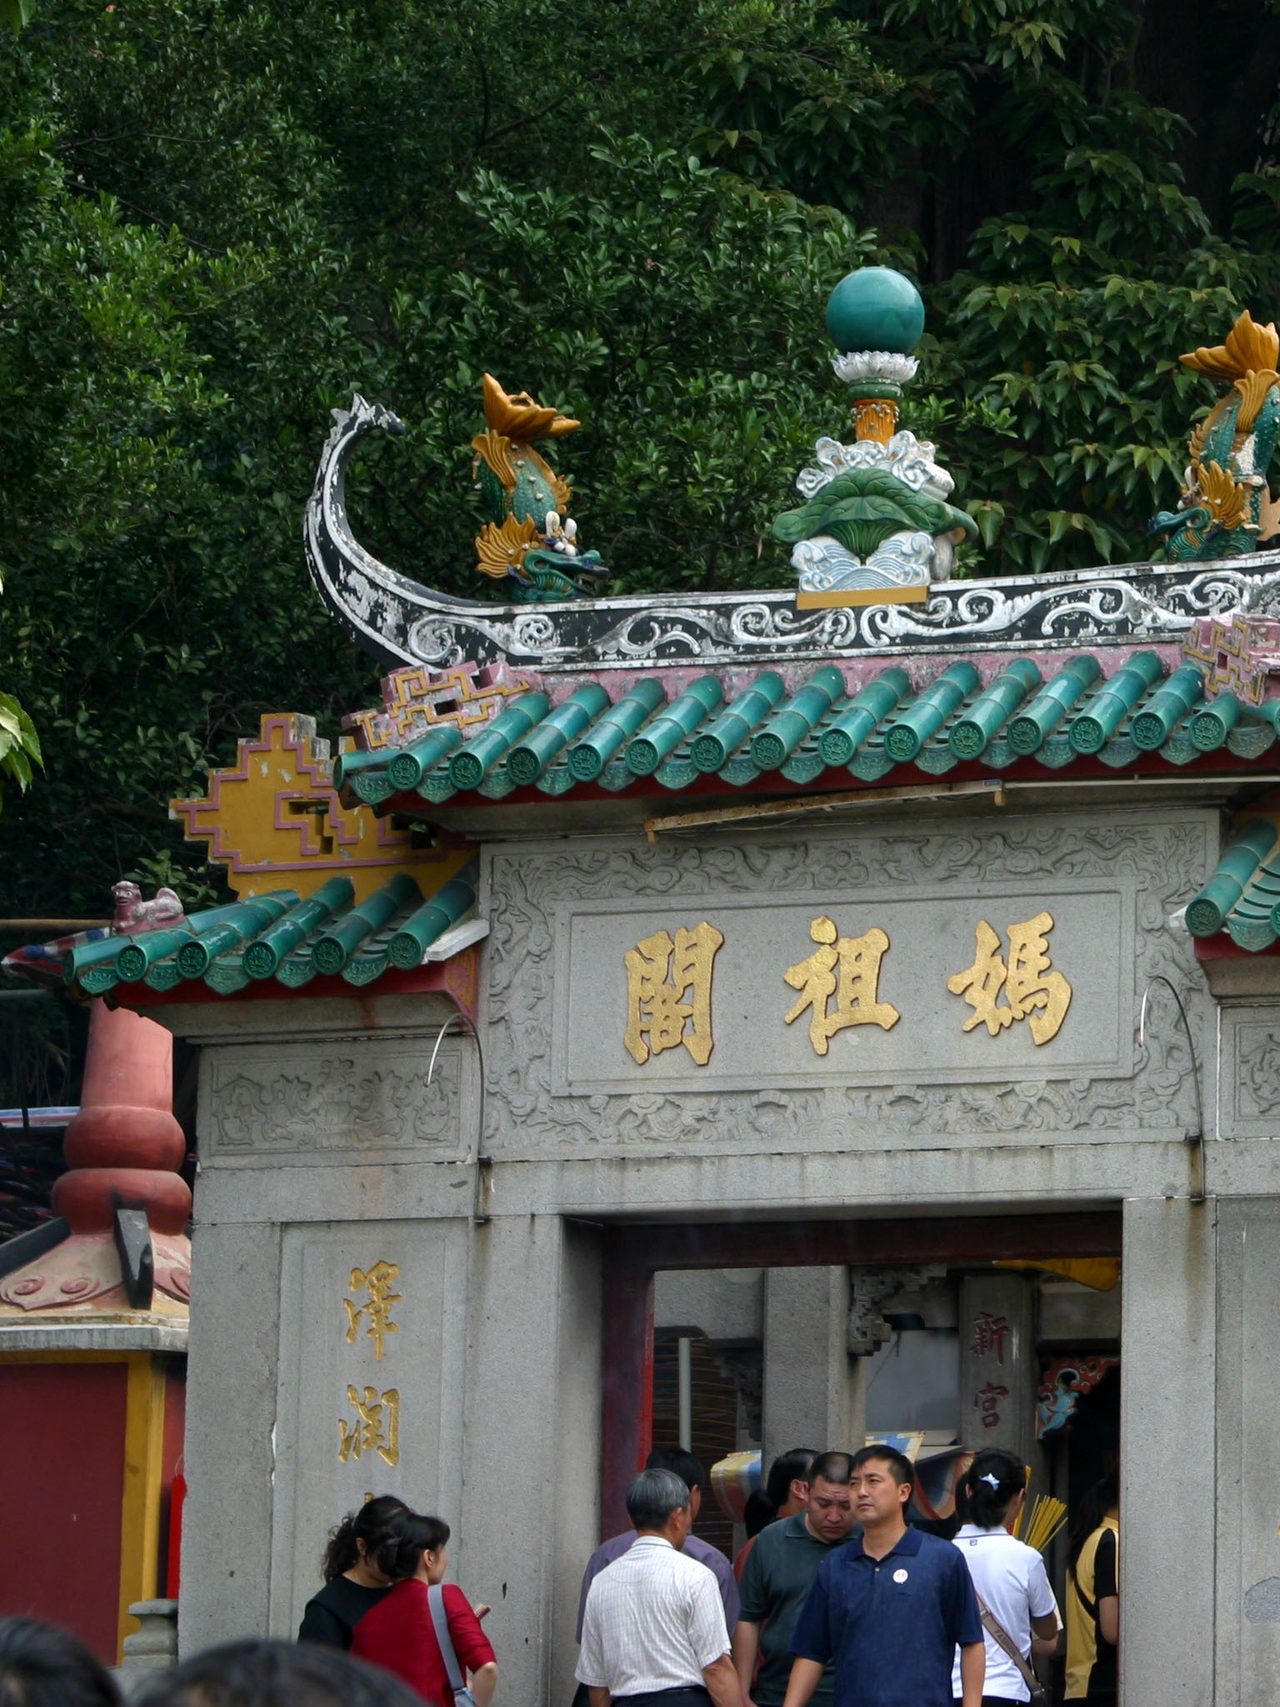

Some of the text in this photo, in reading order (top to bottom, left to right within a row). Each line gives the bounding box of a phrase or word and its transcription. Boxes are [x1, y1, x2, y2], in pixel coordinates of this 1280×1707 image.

[623, 910, 1072, 1067] 媽祖閣
[338, 1259, 404, 1504] 澤潤
[969, 1311, 1010, 1429] 新宮
